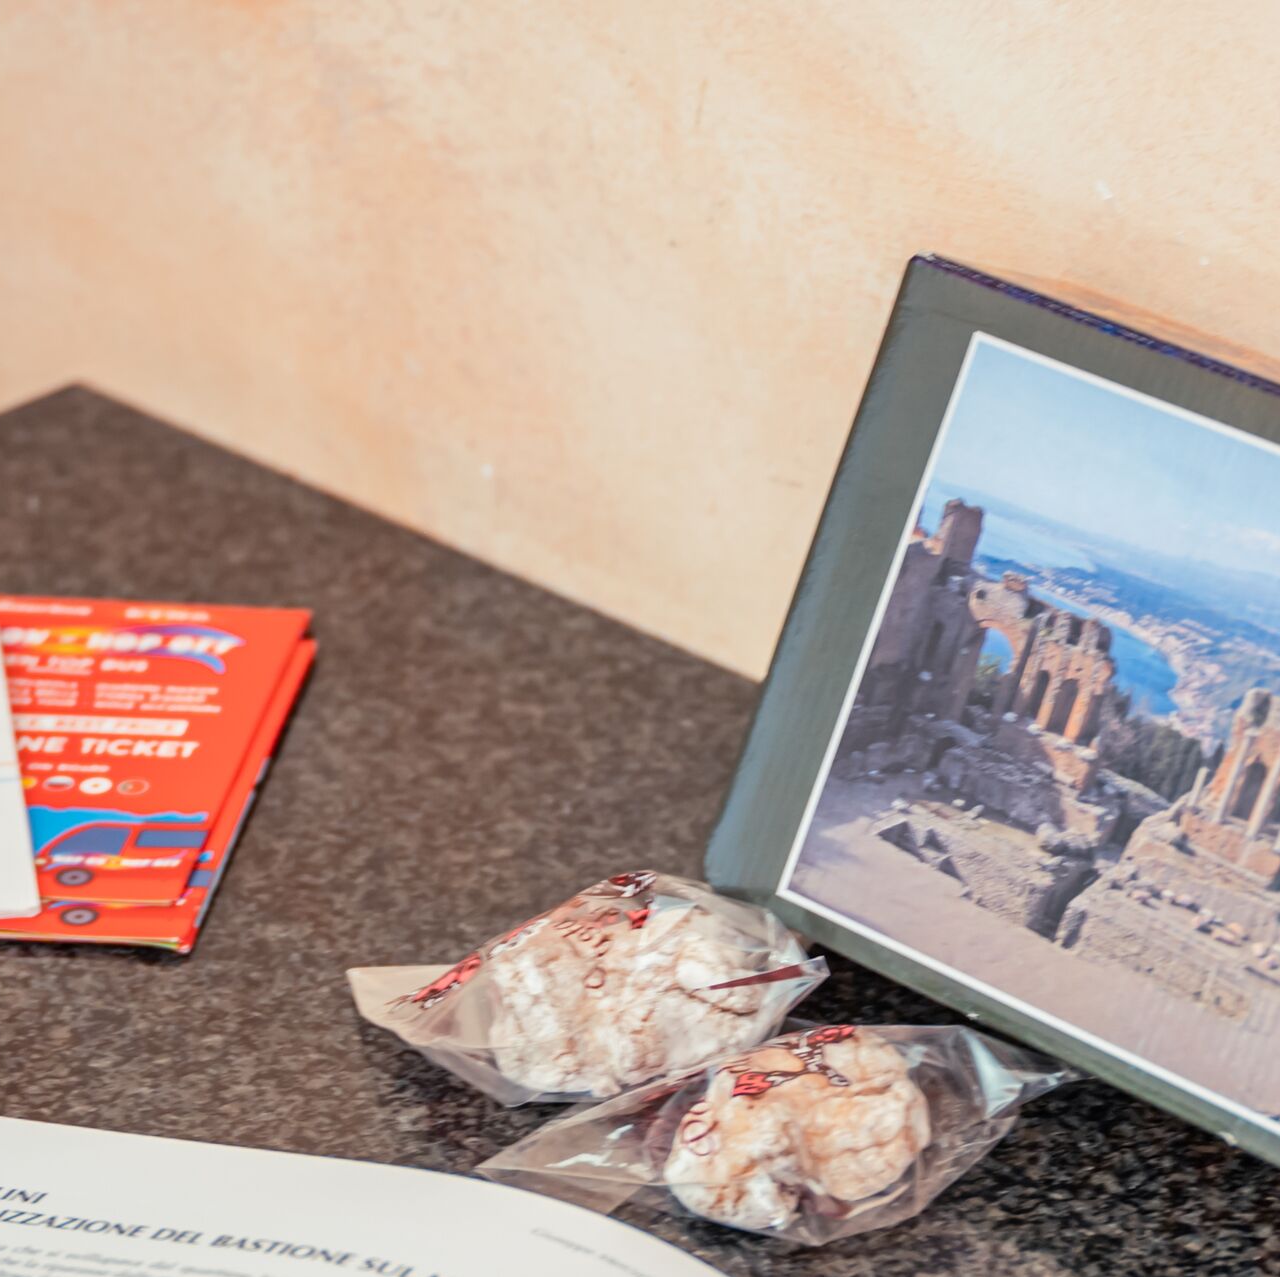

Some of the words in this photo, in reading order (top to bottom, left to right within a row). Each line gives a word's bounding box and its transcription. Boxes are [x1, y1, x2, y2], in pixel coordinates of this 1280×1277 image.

[86, 630, 163, 652] HOP
[100, 659, 148, 672] BUS
[15, 735, 69, 754] NE
[81, 737, 200, 759] TICKET
[150, 1227, 204, 1246] DEL
[209, 1233, 357, 1266] BASTIONE
